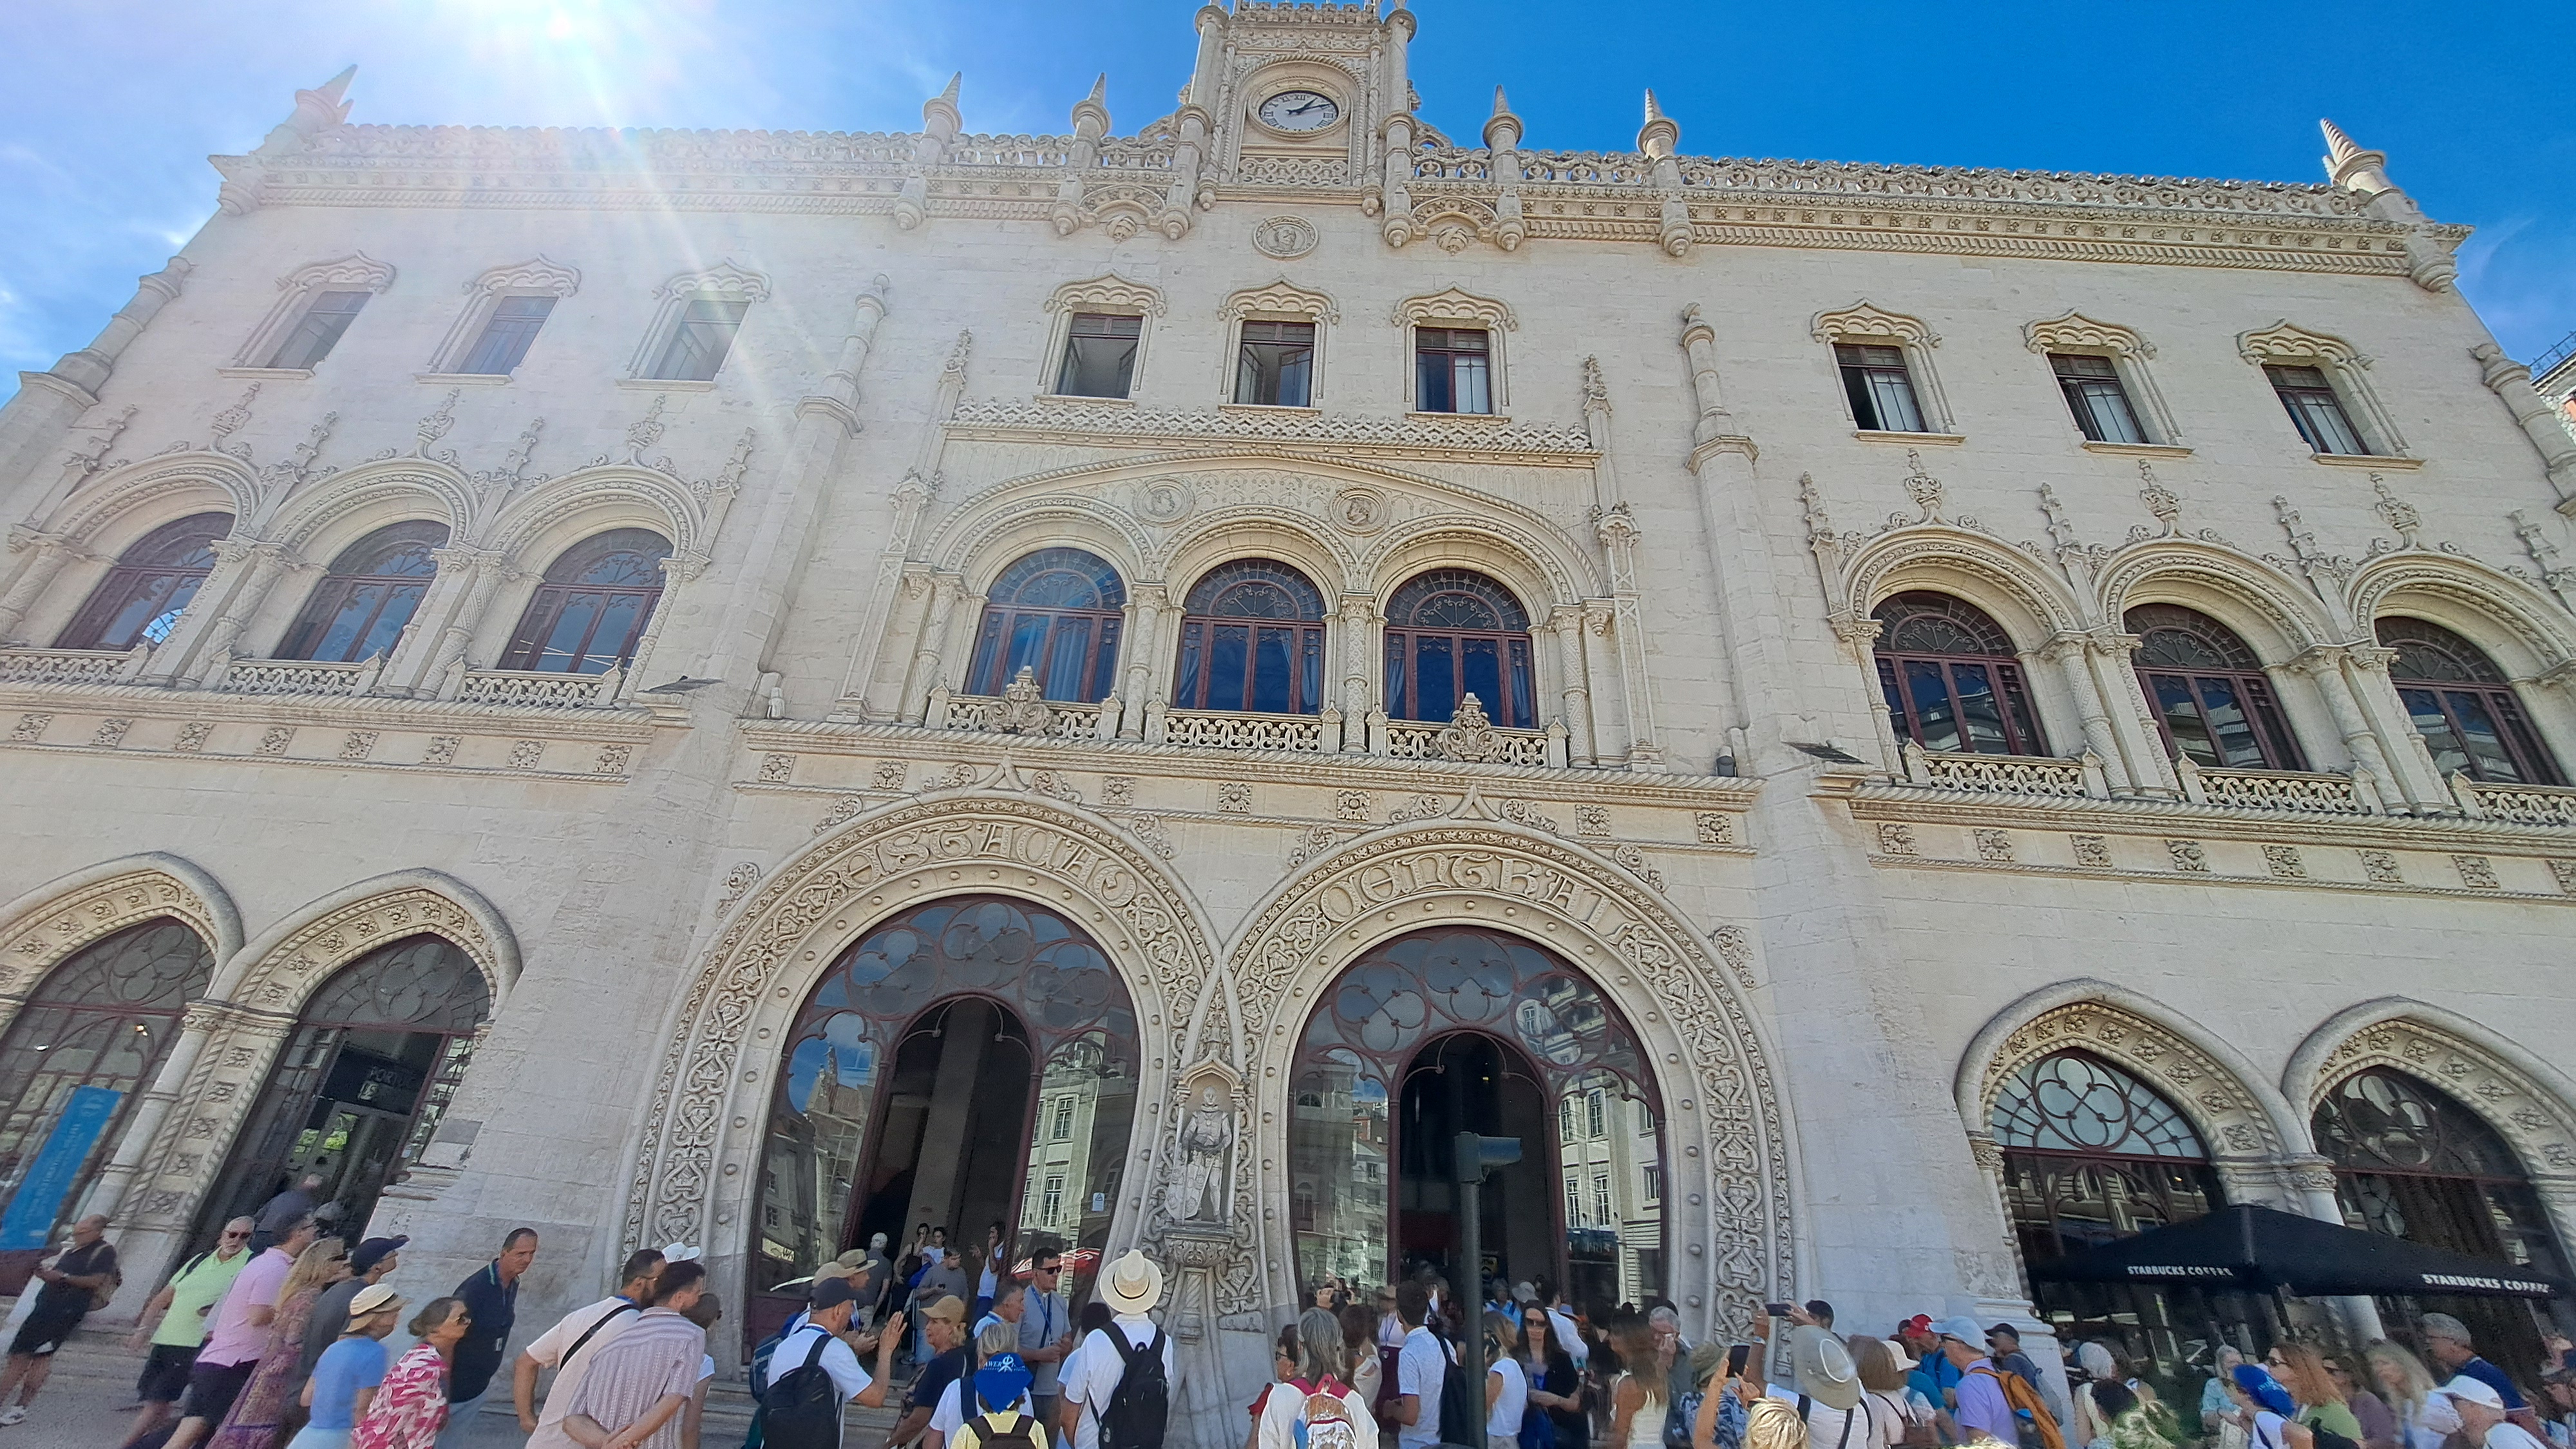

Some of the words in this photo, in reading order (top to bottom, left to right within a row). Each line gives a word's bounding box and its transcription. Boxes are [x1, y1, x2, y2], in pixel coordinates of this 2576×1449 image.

[2127, 1265, 2186, 1276] STARBUCKS
[2188, 1266, 2234, 1277] COFFEE
[2421, 1273, 2501, 1290] STARBUCKS
[2503, 1279, 2551, 1294] COFFEE
